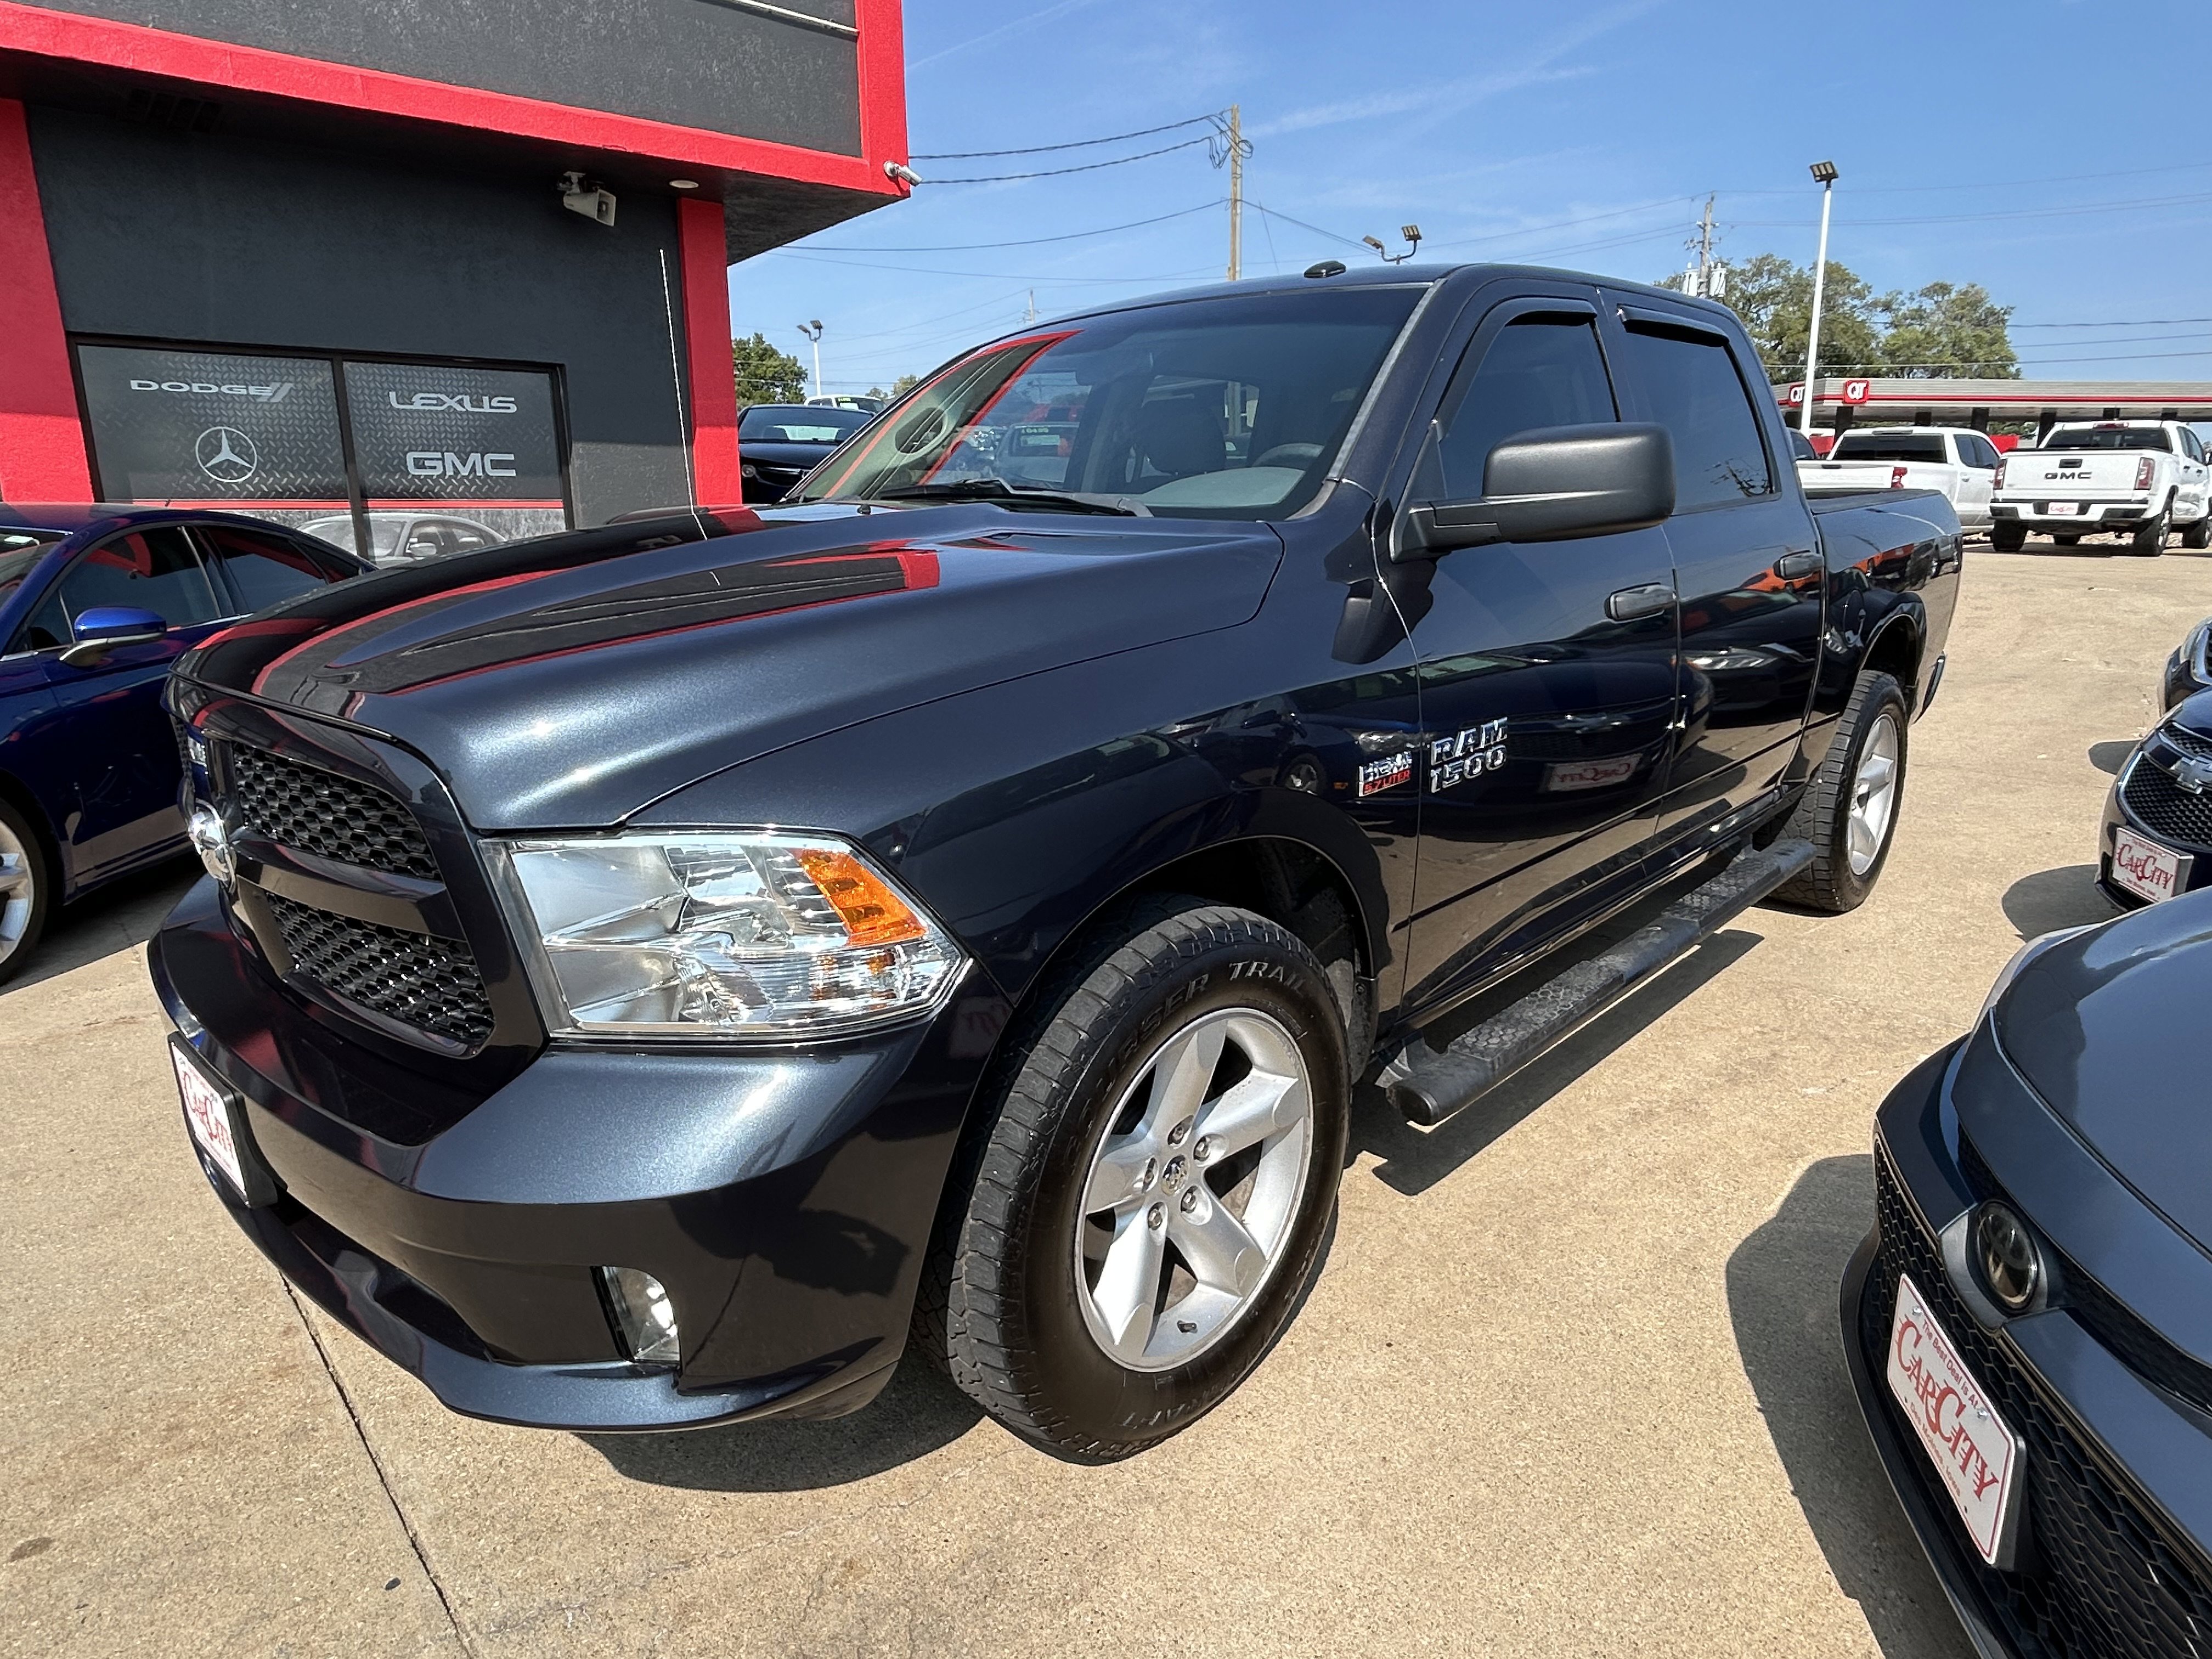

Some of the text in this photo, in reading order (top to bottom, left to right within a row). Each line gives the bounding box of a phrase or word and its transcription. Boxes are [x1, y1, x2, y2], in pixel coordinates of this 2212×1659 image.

[130, 380, 273, 396] DODGE
[1791, 386, 1805, 403] QT
[1847, 382, 1867, 400] QT
[389, 392, 518, 413] LEXUS
[406, 452, 517, 476] GMC
[1430, 716, 1508, 766] RAM
[1359, 751, 1412, 781] HEMI
[1430, 744, 1507, 793] 1500
[1382, 769, 1410, 788] LITER
[1228, 960, 1305, 995] TRAIL
[1922, 1319, 1933, 1341] The
[1932, 1337, 1948, 1363] Best
[1946, 1358, 1963, 1385] Deal
